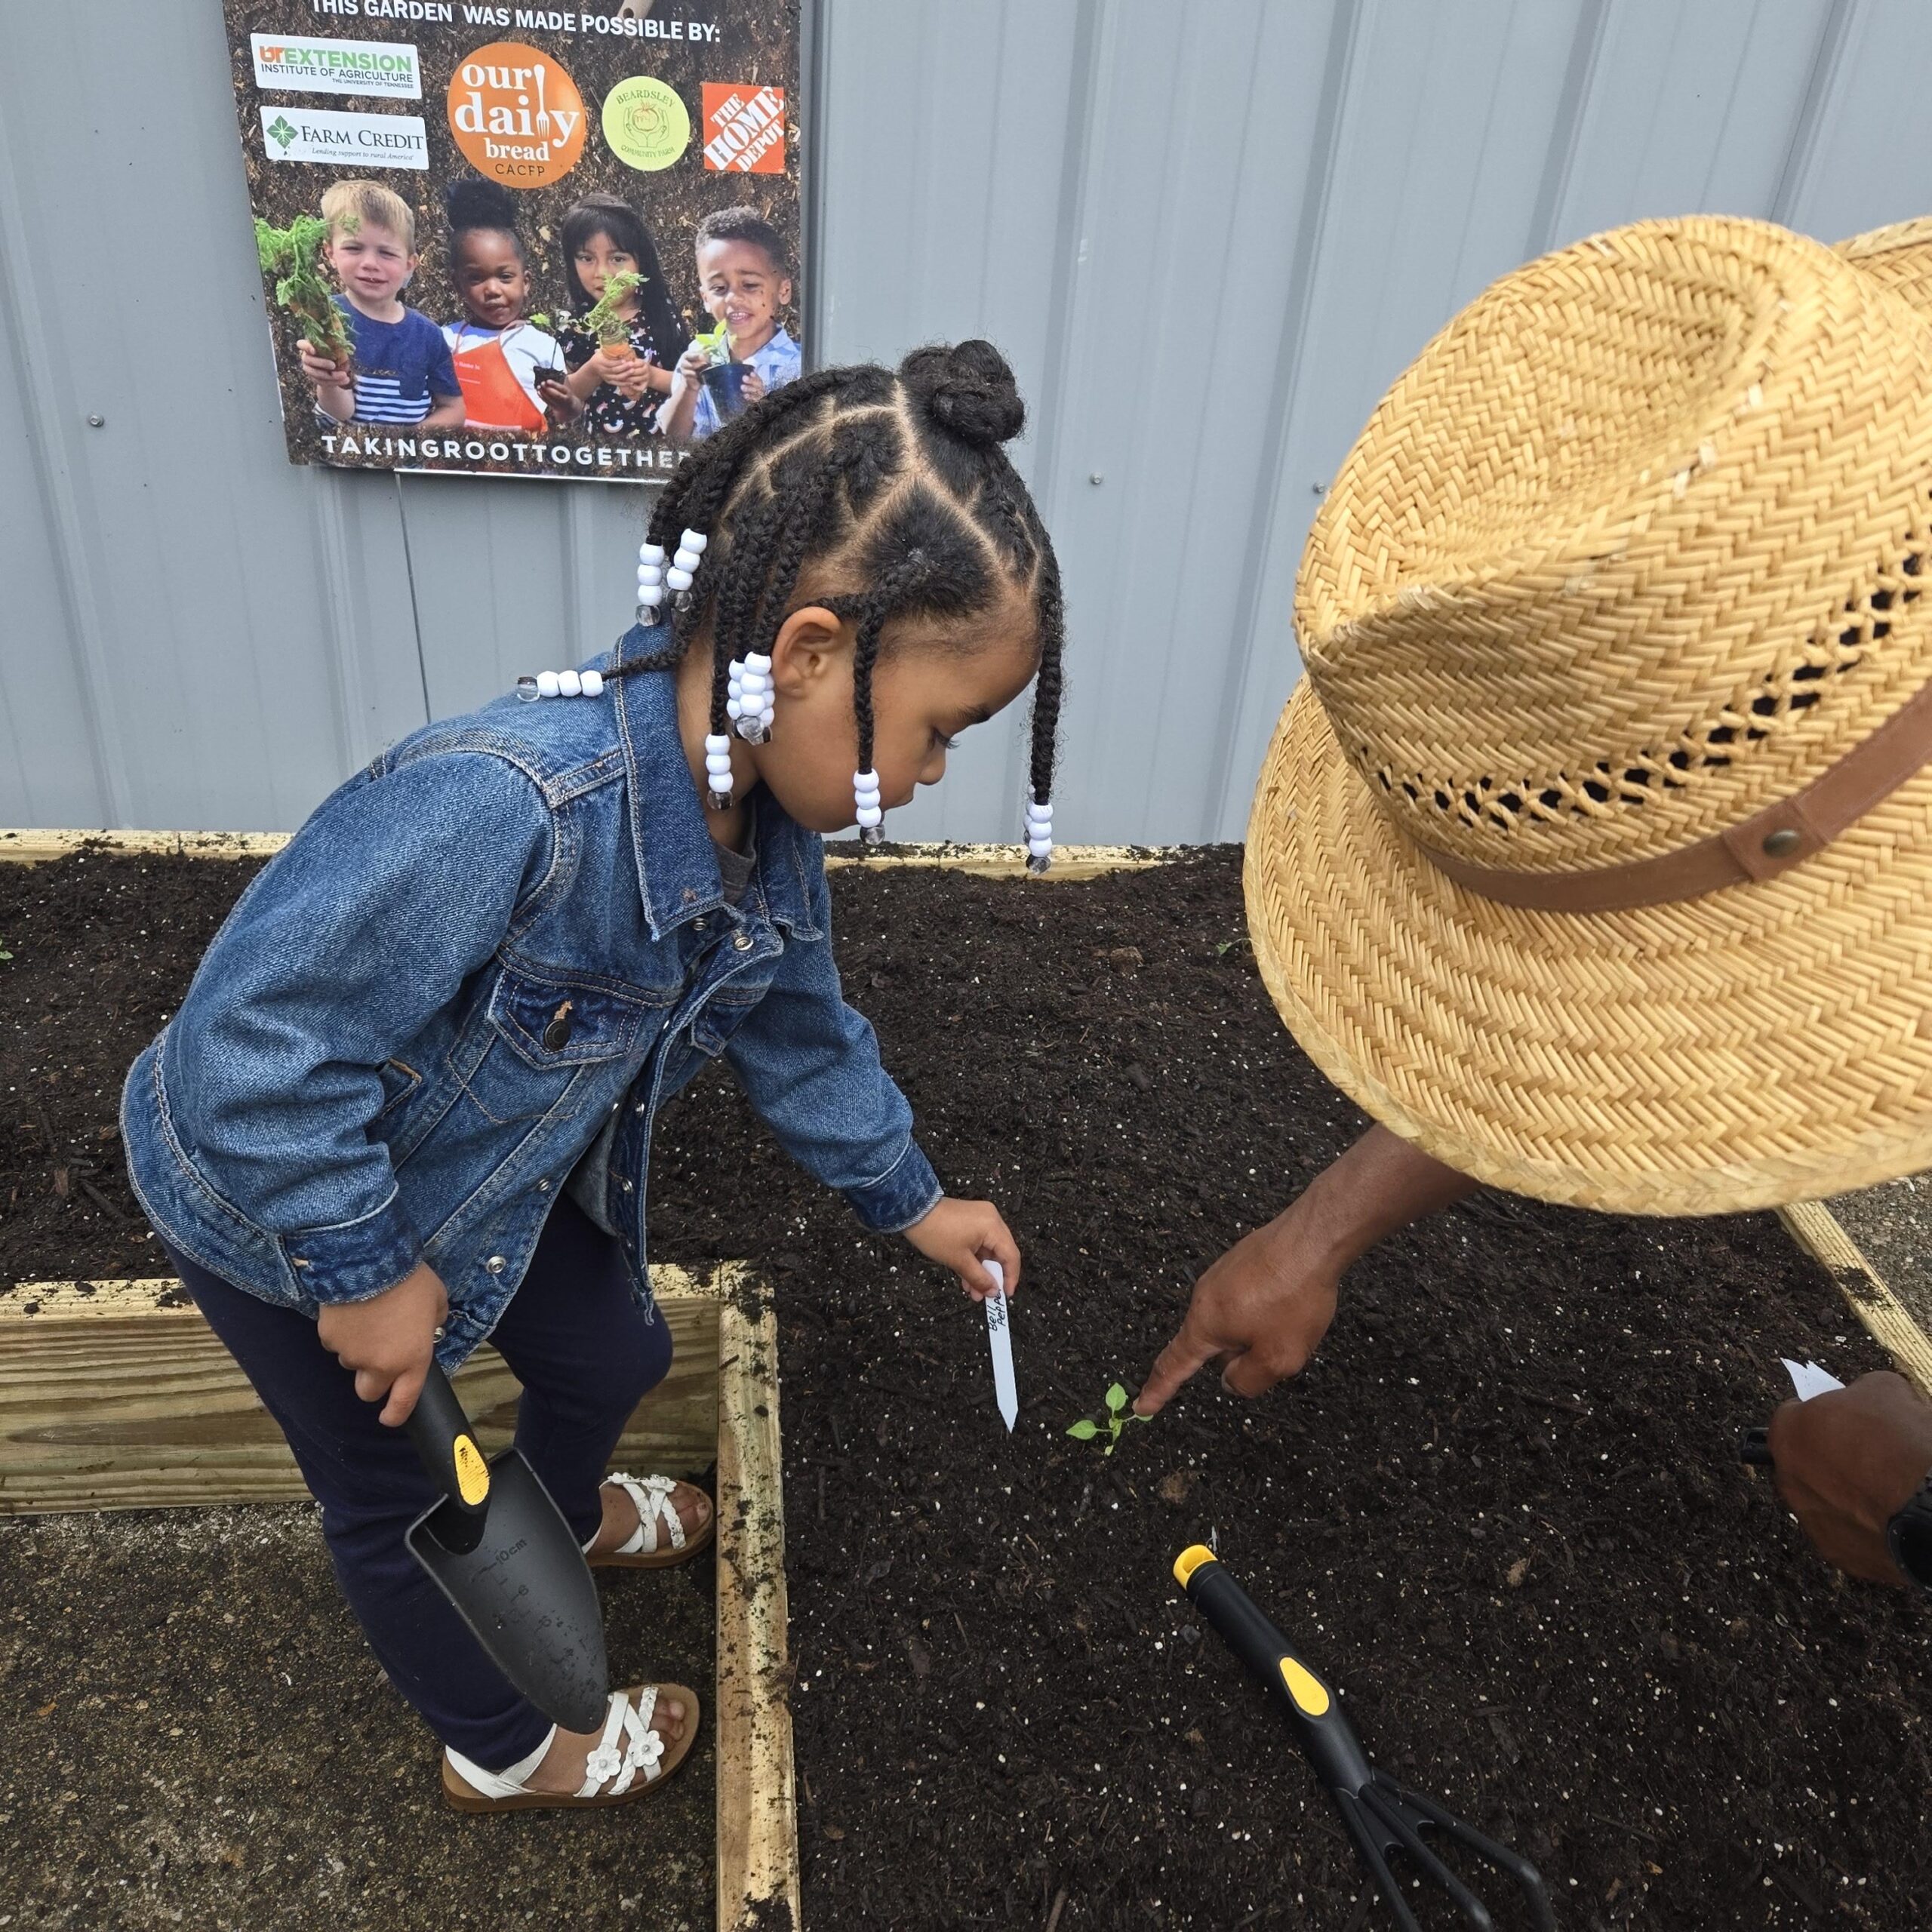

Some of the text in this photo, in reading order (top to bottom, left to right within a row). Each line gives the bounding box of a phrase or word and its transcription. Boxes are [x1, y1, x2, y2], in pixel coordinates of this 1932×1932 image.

[313, 0, 721, 43] THIS GARDEN WAS MADE POSSIBLE BY:
[261, 63, 414, 83] INSTITUTE OF AGRICULTURE
[285, 48, 412, 72] EXTENSION
[461, 63, 533, 91] our
[616, 90, 675, 107] BEARDSLEY
[709, 92, 746, 128] THE
[300, 125, 424, 150] FARM CREDIT
[703, 85, 785, 171] HOME
[312, 147, 337, 156] Lending
[338, 149, 361, 158] support
[483, 137, 550, 162] bread
[735, 118, 785, 173] DEPOT
[494, 163, 545, 177] CACFP
[987, 1305, 997, 1331] Bell
[994, 1288, 1005, 1327] peppe
[495, 1538, 528, 1564] 10cm
